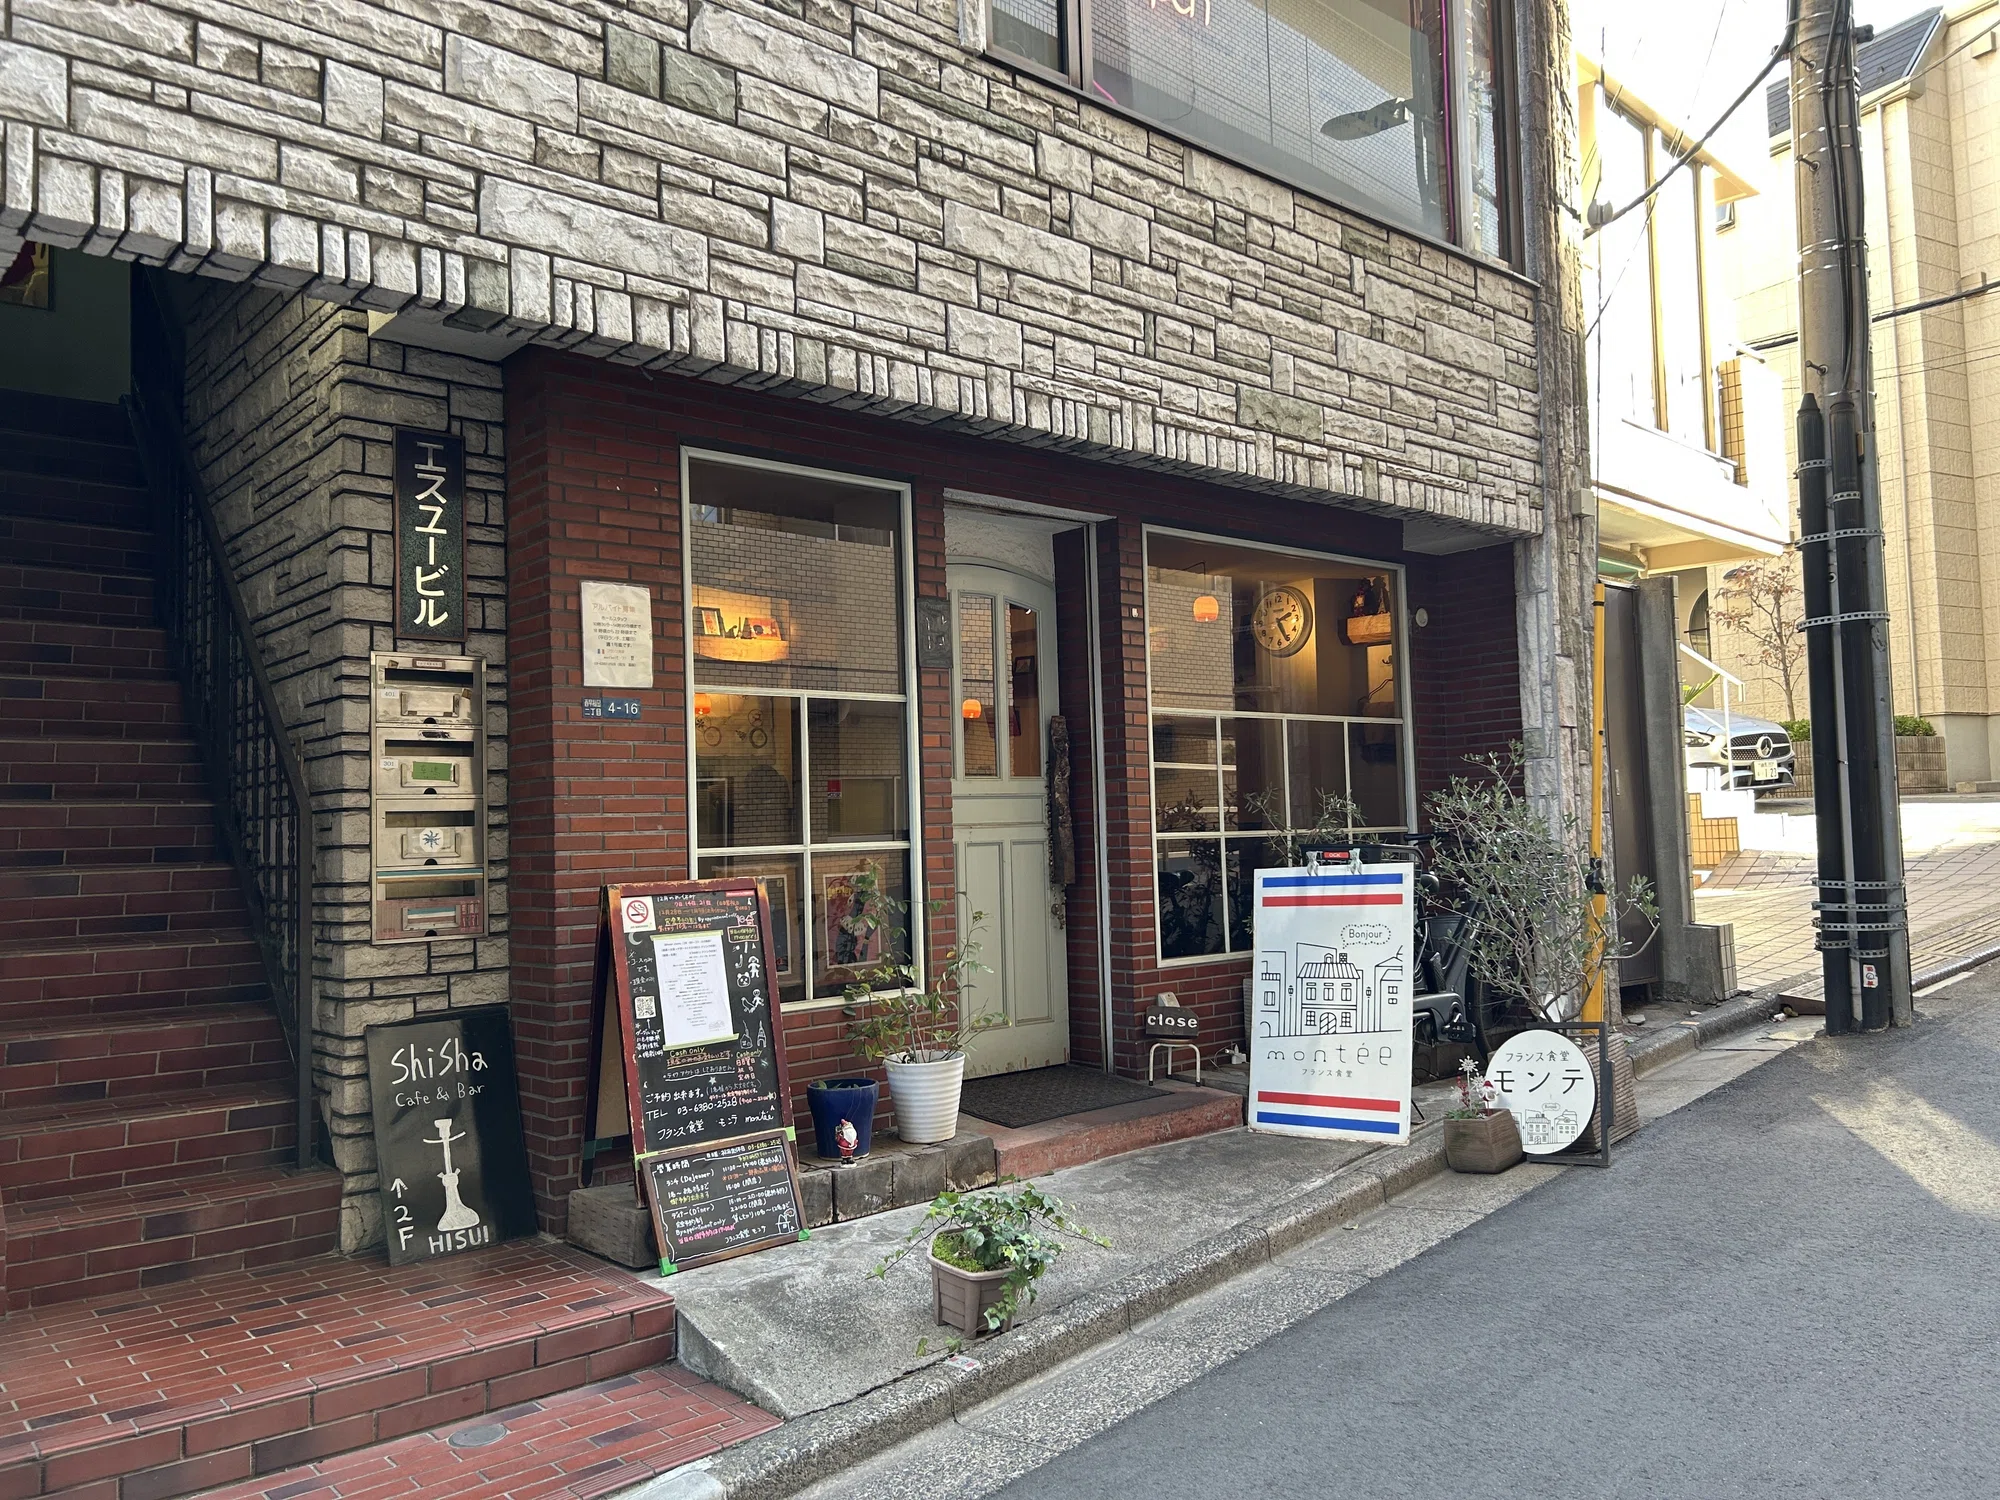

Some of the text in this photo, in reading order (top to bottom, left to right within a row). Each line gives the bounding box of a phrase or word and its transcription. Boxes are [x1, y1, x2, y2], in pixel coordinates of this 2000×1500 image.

[413, 441, 449, 627] エスユービル
[584, 708, 602, 716] 二丁目
[608, 702, 638, 715] 4-16
[1349, 929, 1383, 940] Bonjour
[1147, 1013, 1198, 1028] close
[669, 1048, 687, 1057] Cash
[1267, 1043, 1392, 1066] montée
[1505, 1050, 1570, 1063] フランス食堂
[1302, 1068, 1353, 1078] フランス食堂
[1494, 1069, 1584, 1094] モンテ
[395, 1082, 485, 1108] Cafe & Bar
[645, 1091, 671, 1104] ご予約
[645, 1109, 668, 1121] TEL
[677, 1096, 738, 1115] 03-6380-2528
[657, 1118, 705, 1140] フランス食堂
[656, 1159, 690, 1174] 営業時間
[428, 1225, 489, 1254] HISUI
